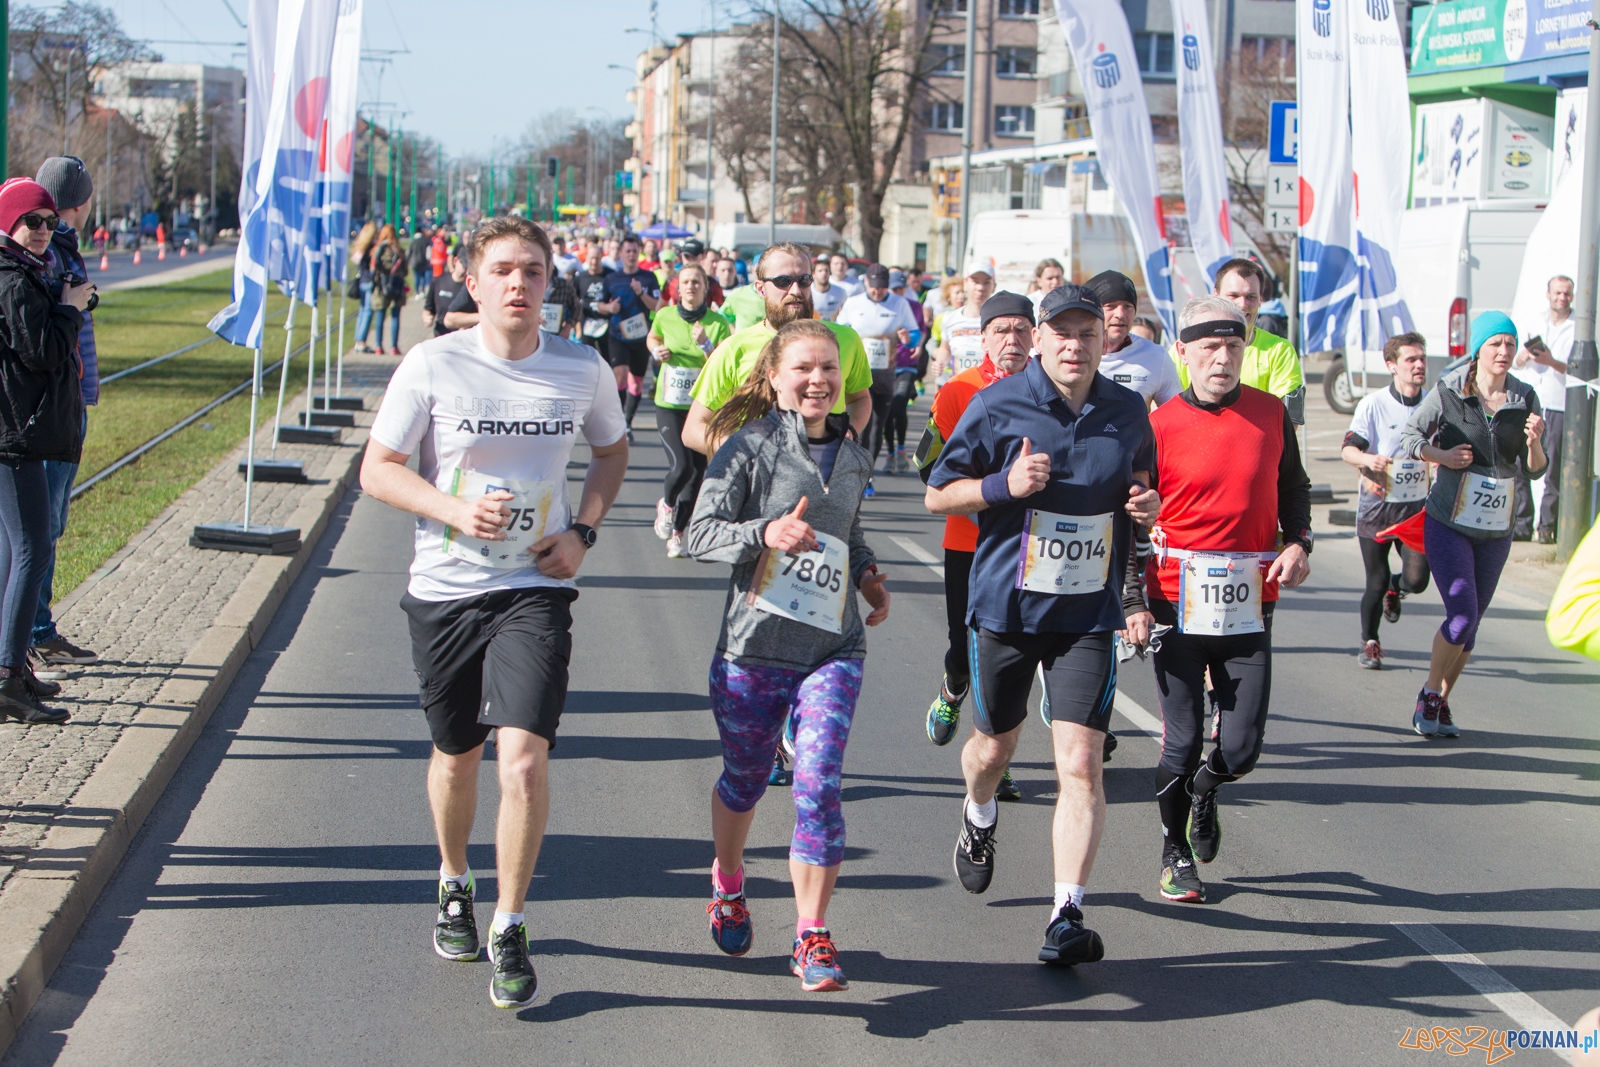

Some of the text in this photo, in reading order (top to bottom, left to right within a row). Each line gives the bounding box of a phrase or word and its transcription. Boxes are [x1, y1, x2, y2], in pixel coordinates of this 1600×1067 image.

[1568, 11, 1593, 28] MIKRO
[1380, 34, 1401, 46] Polsk
[23, 250, 44, 266] Canon
[455, 396, 576, 419] UNDER
[456, 419, 574, 436] ARMOUR
[1395, 470, 1426, 485] 5992
[1472, 490, 1507, 509] 7261
[501, 507, 536, 532] 75
[1036, 536, 1106, 562] 10014
[781, 553, 842, 593] 7805
[1200, 583, 1249, 604] 1180
